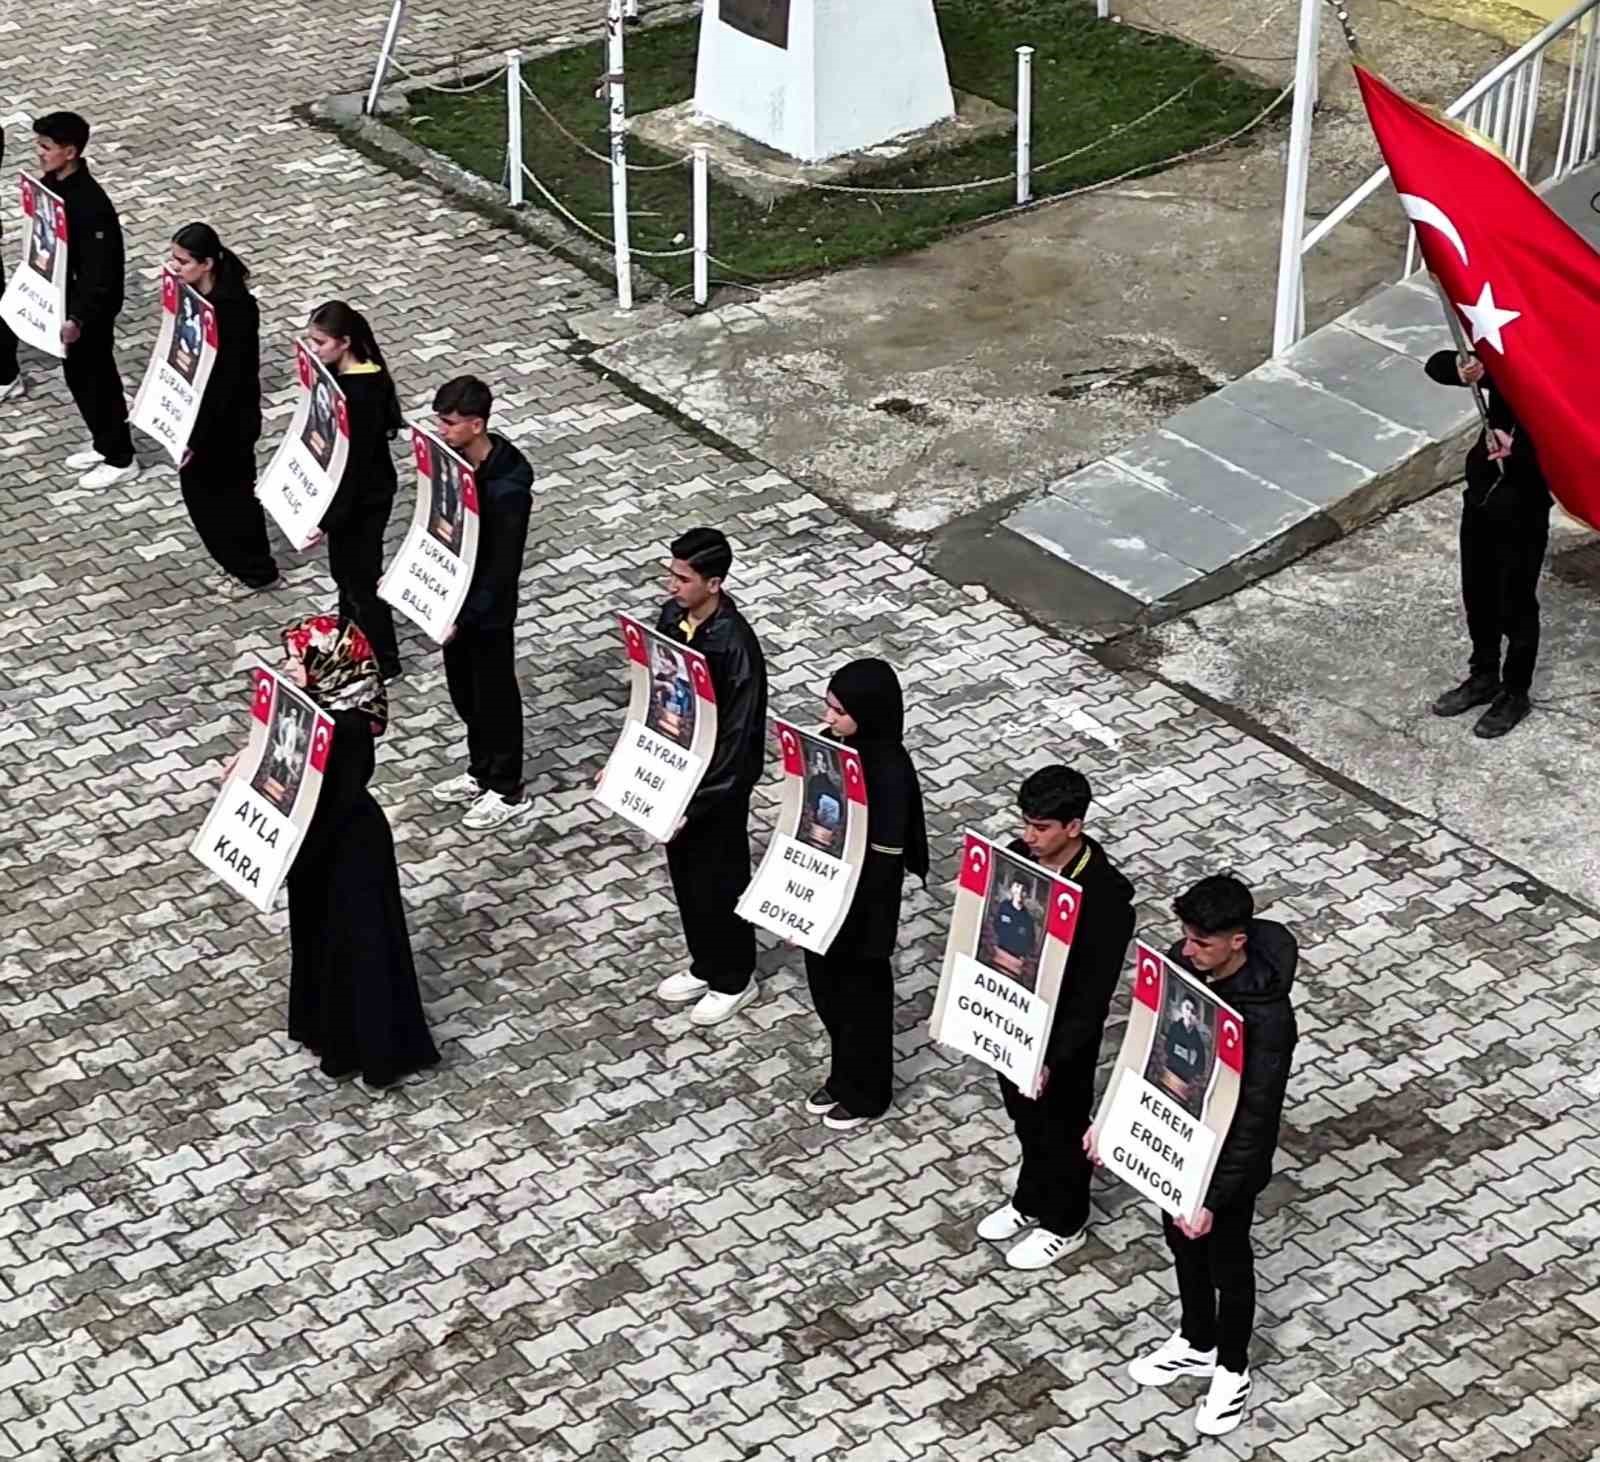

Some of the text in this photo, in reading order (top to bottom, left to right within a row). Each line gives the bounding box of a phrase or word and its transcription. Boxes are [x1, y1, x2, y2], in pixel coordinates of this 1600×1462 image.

[420, 539, 457, 577] FURKAN
[409, 562, 448, 600] SANCAK
[401, 588, 432, 621] BALAL
[636, 734, 688, 771] BAYRAM
[235, 800, 280, 848] AYLA
[213, 834, 262, 888] KARA
[785, 880, 815, 903] NUR
[759, 900, 815, 935] BOYRAZ
[974, 973, 1031, 1014] ADNAN
[1140, 1091, 1195, 1143] KEREM
[1130, 1121, 1185, 1171] ERDEM
